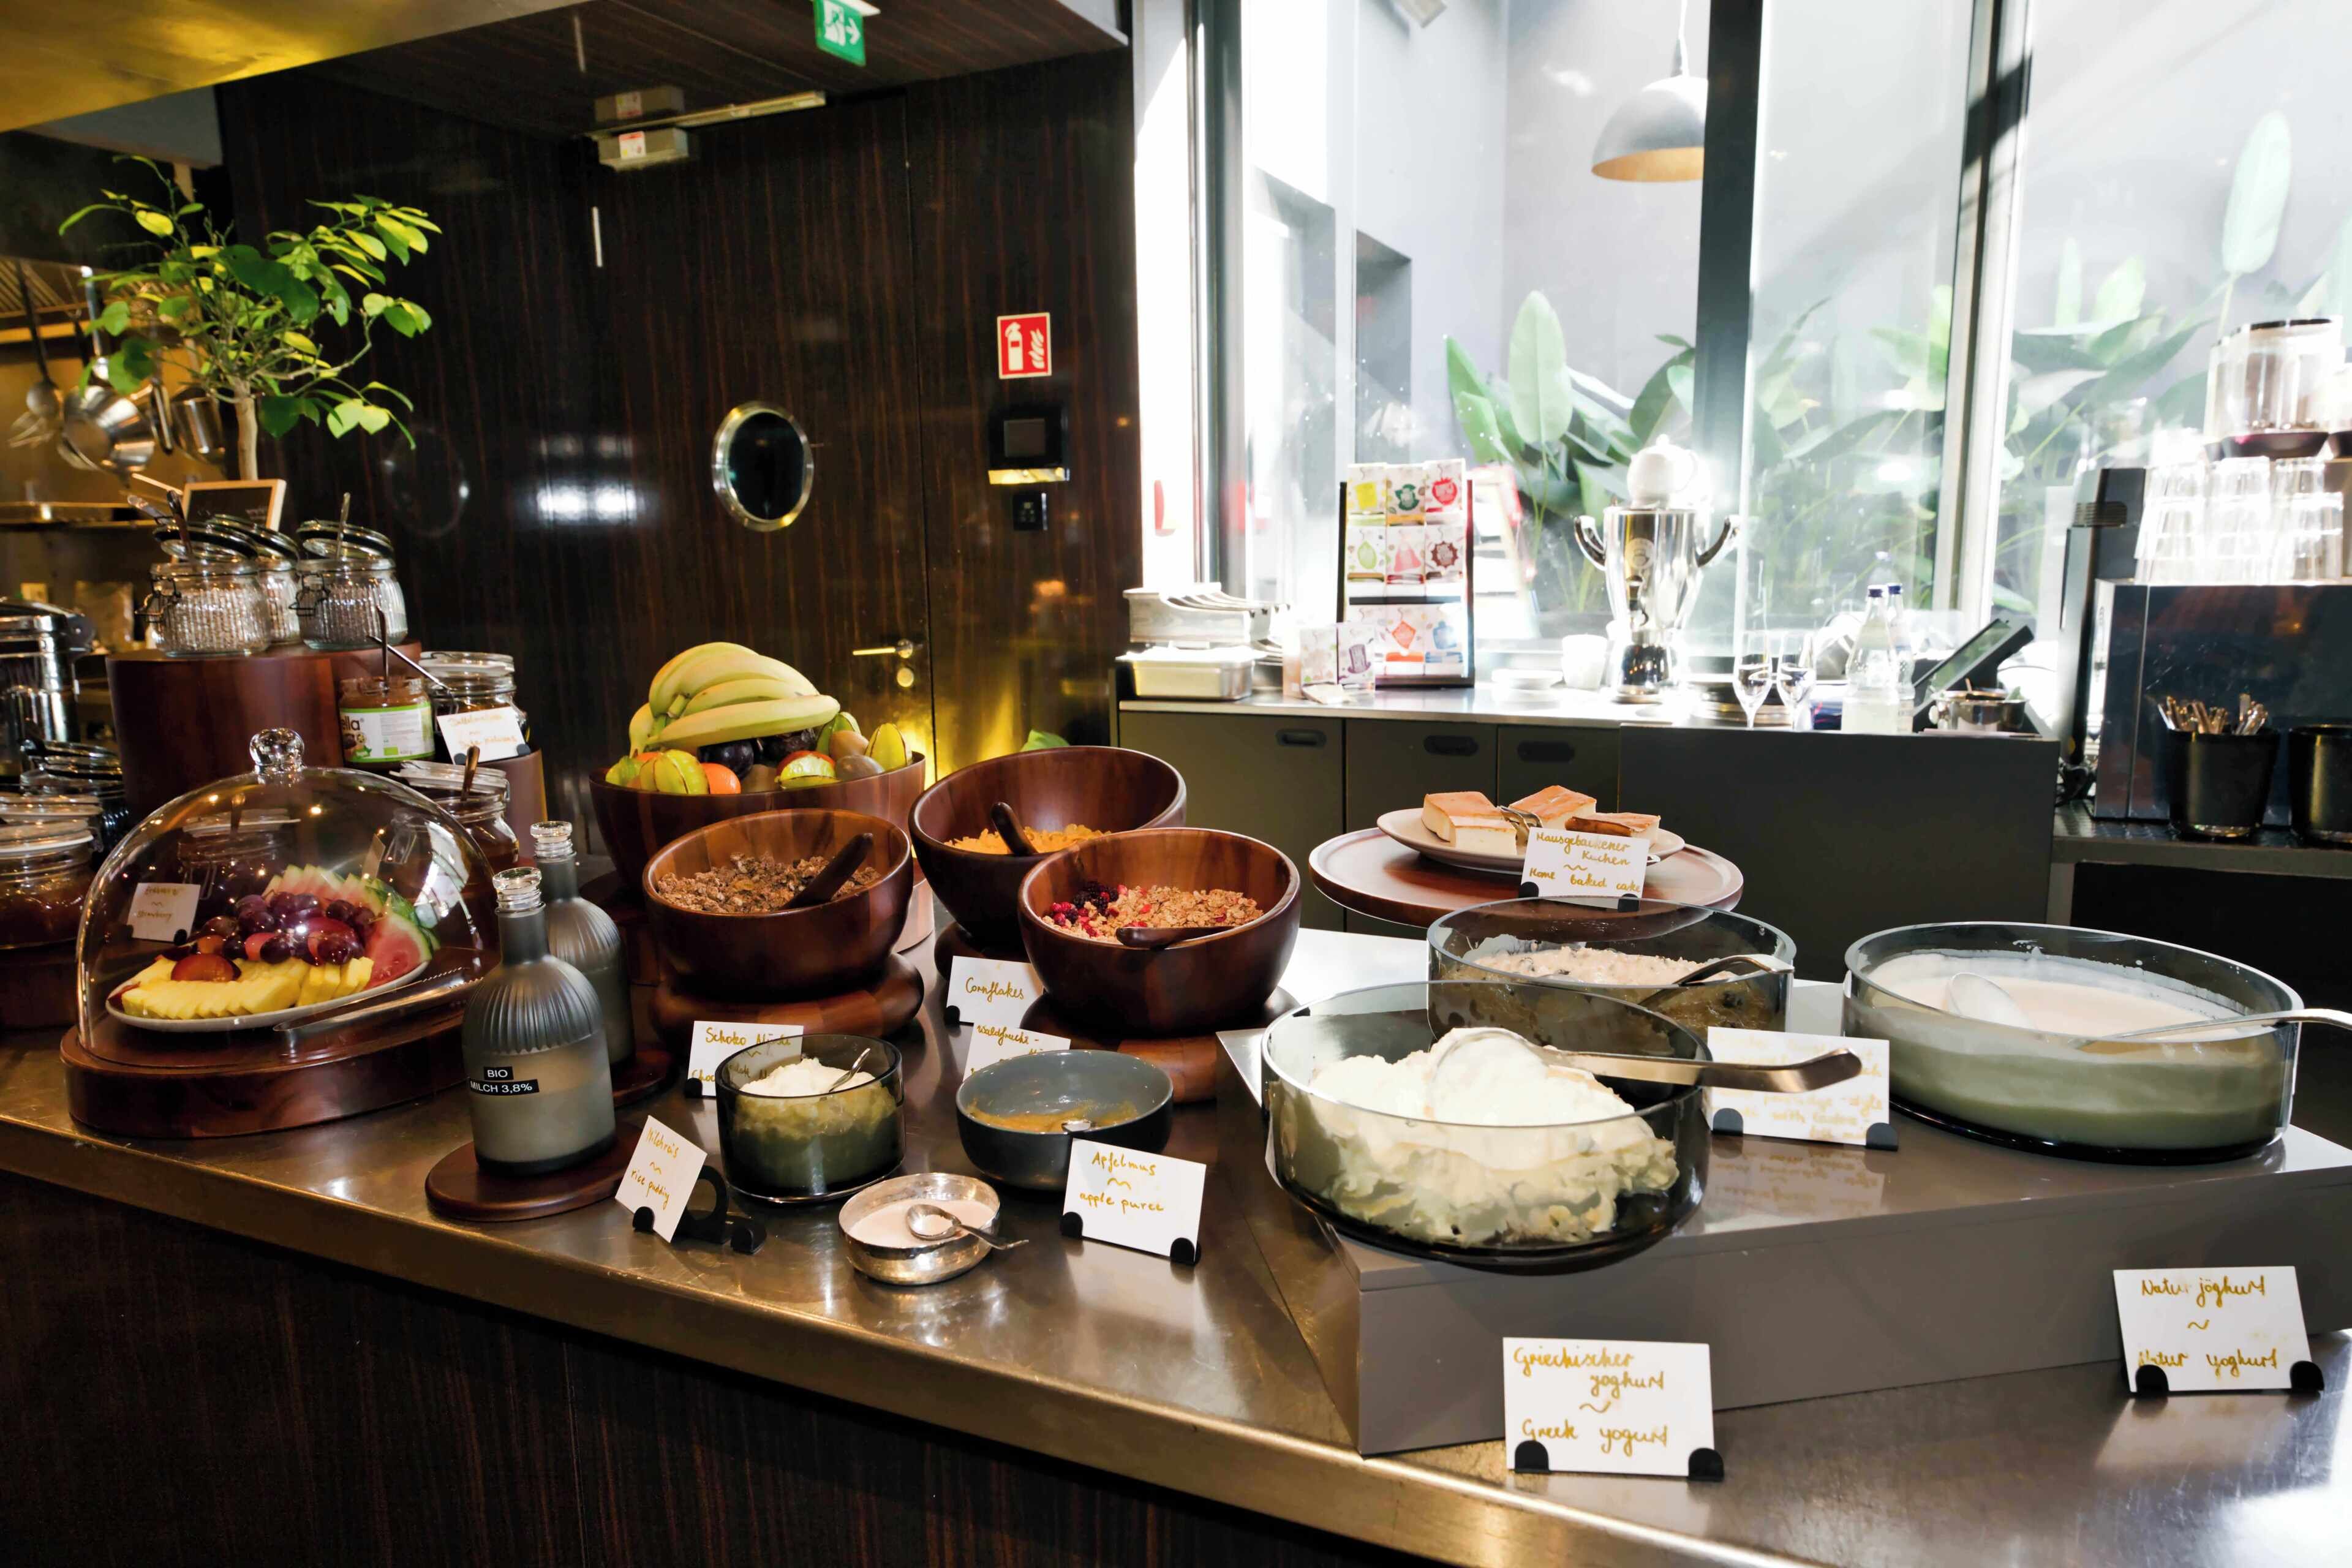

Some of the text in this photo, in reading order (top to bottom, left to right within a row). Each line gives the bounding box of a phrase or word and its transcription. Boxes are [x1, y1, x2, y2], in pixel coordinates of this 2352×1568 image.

[1529, 867, 1555, 880] Home
[1570, 873, 1607, 888] baked
[965, 977, 1024, 1003] Cornflakes
[706, 1027, 747, 1046] Schoko
[470, 1080, 532, 1093] MILCH 3,8%
[1091, 1152, 1156, 1176] Apfelmus
[631, 1168, 671, 1210] rice pudding
[1080, 1193, 1164, 1215] apple puree
[1513, 1345, 1634, 1377] Griechischer
[1522, 1419, 1668, 1457] Greek yogurt
